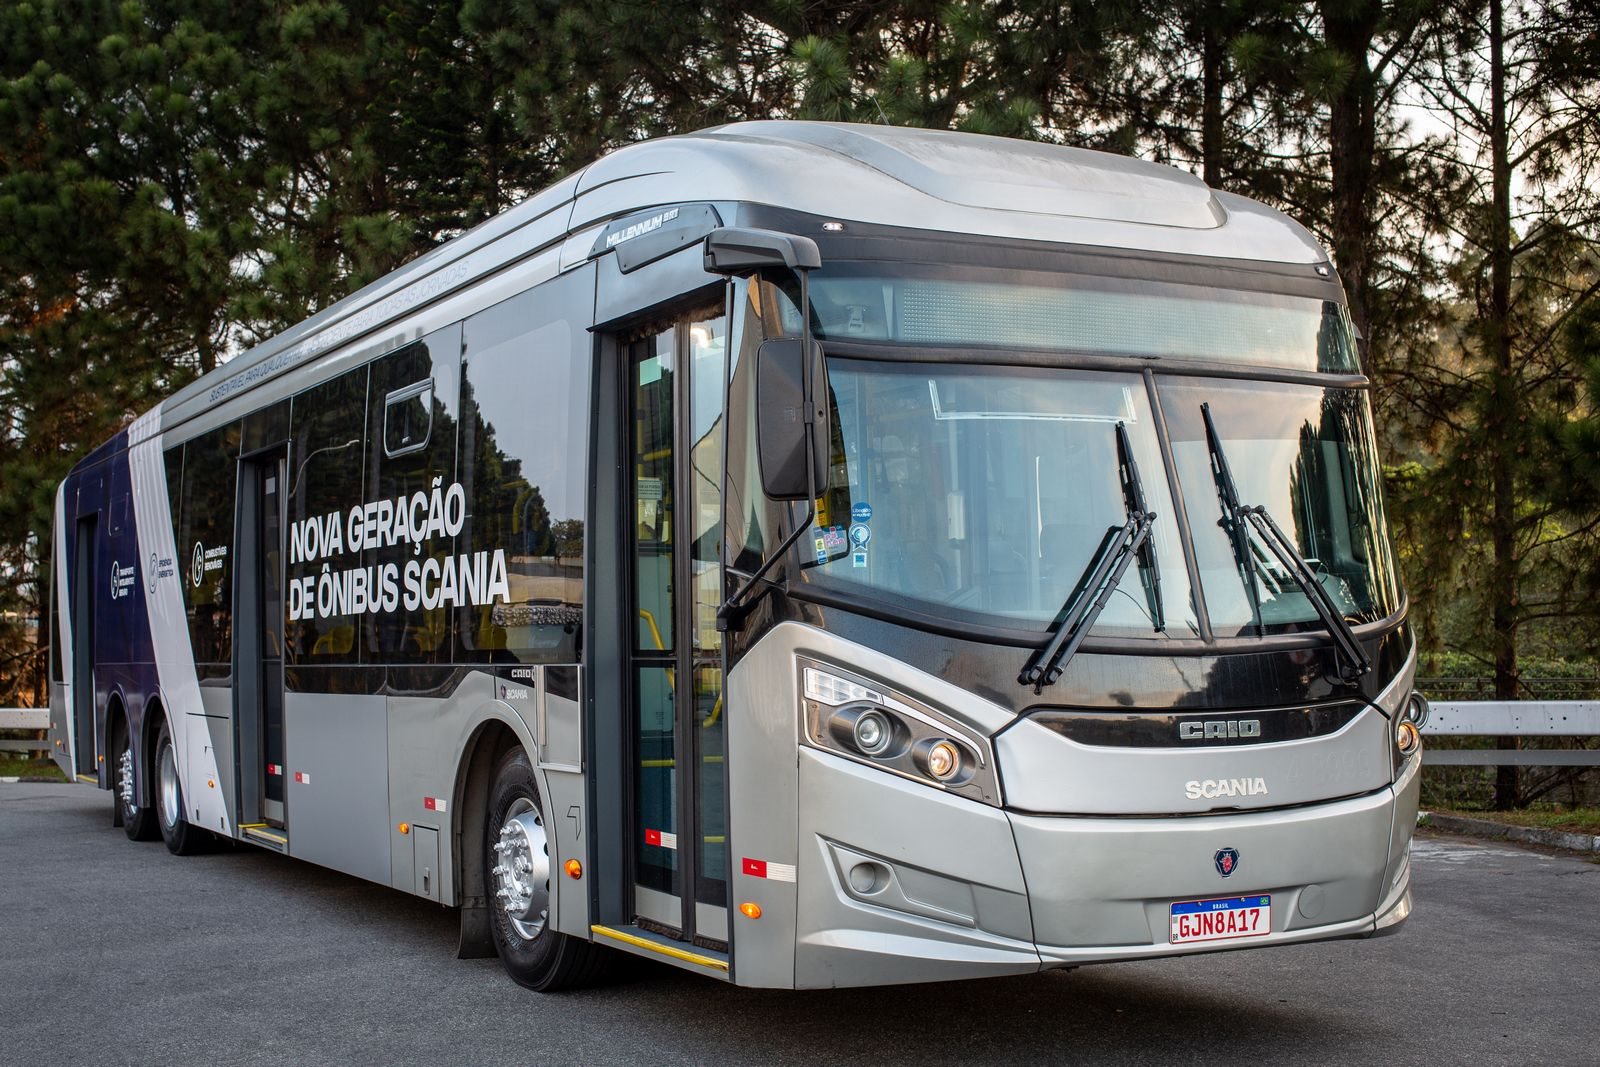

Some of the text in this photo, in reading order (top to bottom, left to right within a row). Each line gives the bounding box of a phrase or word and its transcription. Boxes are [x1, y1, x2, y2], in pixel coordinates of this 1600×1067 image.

[606, 214, 663, 248] MILLENNIUM
[290, 476, 466, 564] NOVA GERAÇÃO
[290, 548, 511, 621] DE ÔNIBUS SCANIA
[512, 669, 531, 678] CAIO
[506, 688, 528, 700] SCANIA
[1180, 720, 1261, 740] CAIO
[1185, 778, 1268, 800] SCANIA
[1179, 908, 1260, 938] GJN8A17
